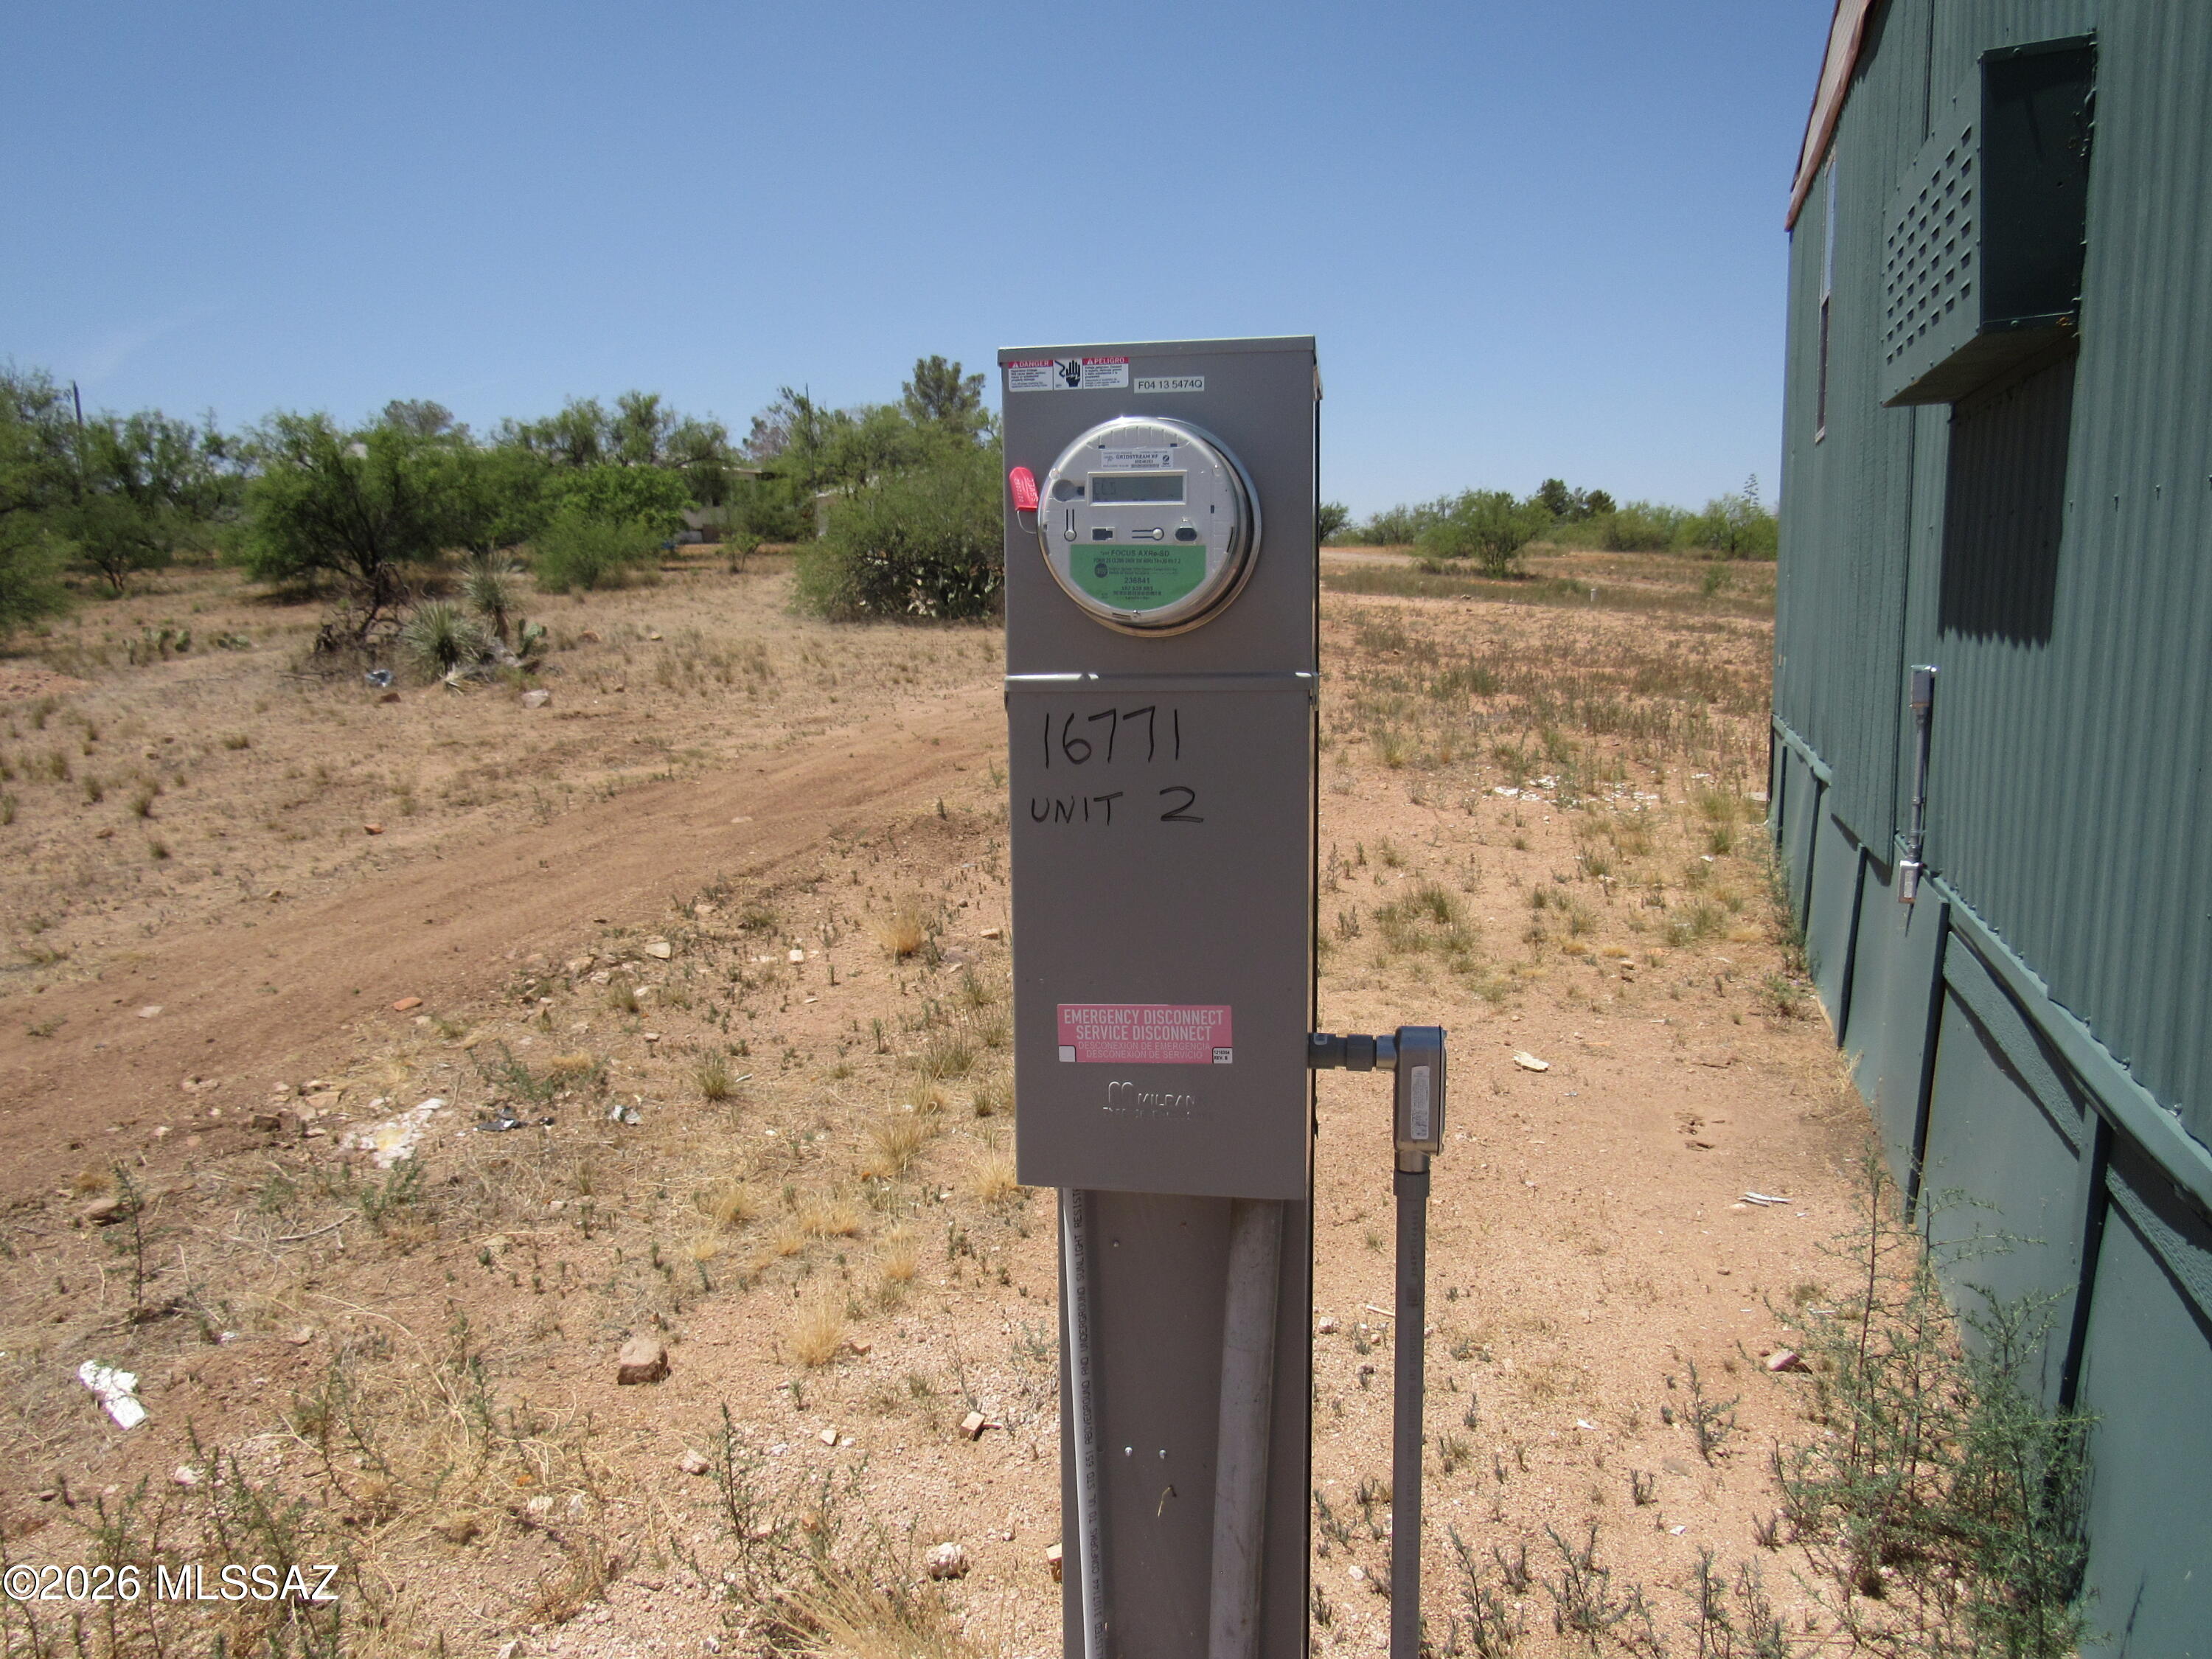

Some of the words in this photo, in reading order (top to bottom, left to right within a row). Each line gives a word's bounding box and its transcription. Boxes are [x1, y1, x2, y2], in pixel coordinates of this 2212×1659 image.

[1138, 380, 1155, 390] F04
[1159, 380, 1169, 389] 13
[1172, 379, 1203, 389] 5474Q
[1044, 705, 1180, 769] 16771
[1031, 790, 1124, 826] UNIT
[1159, 785, 1204, 824] 2
[1064, 1009, 1139, 1024] EMERGENCY
[1144, 1009, 1224, 1026] DISCONNECT
[1076, 1025, 1129, 1040] SERVICE
[1133, 1026, 1212, 1041] DISCONNECT
[1141, 1041, 1152, 1050] DE
[1155, 1041, 1211, 1051] EMERGENCIA
[1150, 1050, 1160, 1059] DE
[1164, 1050, 1203, 1060] SERVICIO
[1074, 1234, 1085, 1281] SUNLIGHT
[1077, 1287, 1088, 1352] UNDERGROUND
[1080, 1357, 1089, 1376] AND
[1082, 1380, 1093, 1444] ABOVEGROUND
[1085, 1450, 1094, 1467] 651
[1086, 1472, 1096, 1490] STD
[1088, 1511, 1097, 1524] TO
[1090, 1528, 1099, 1574] CONFORMS
